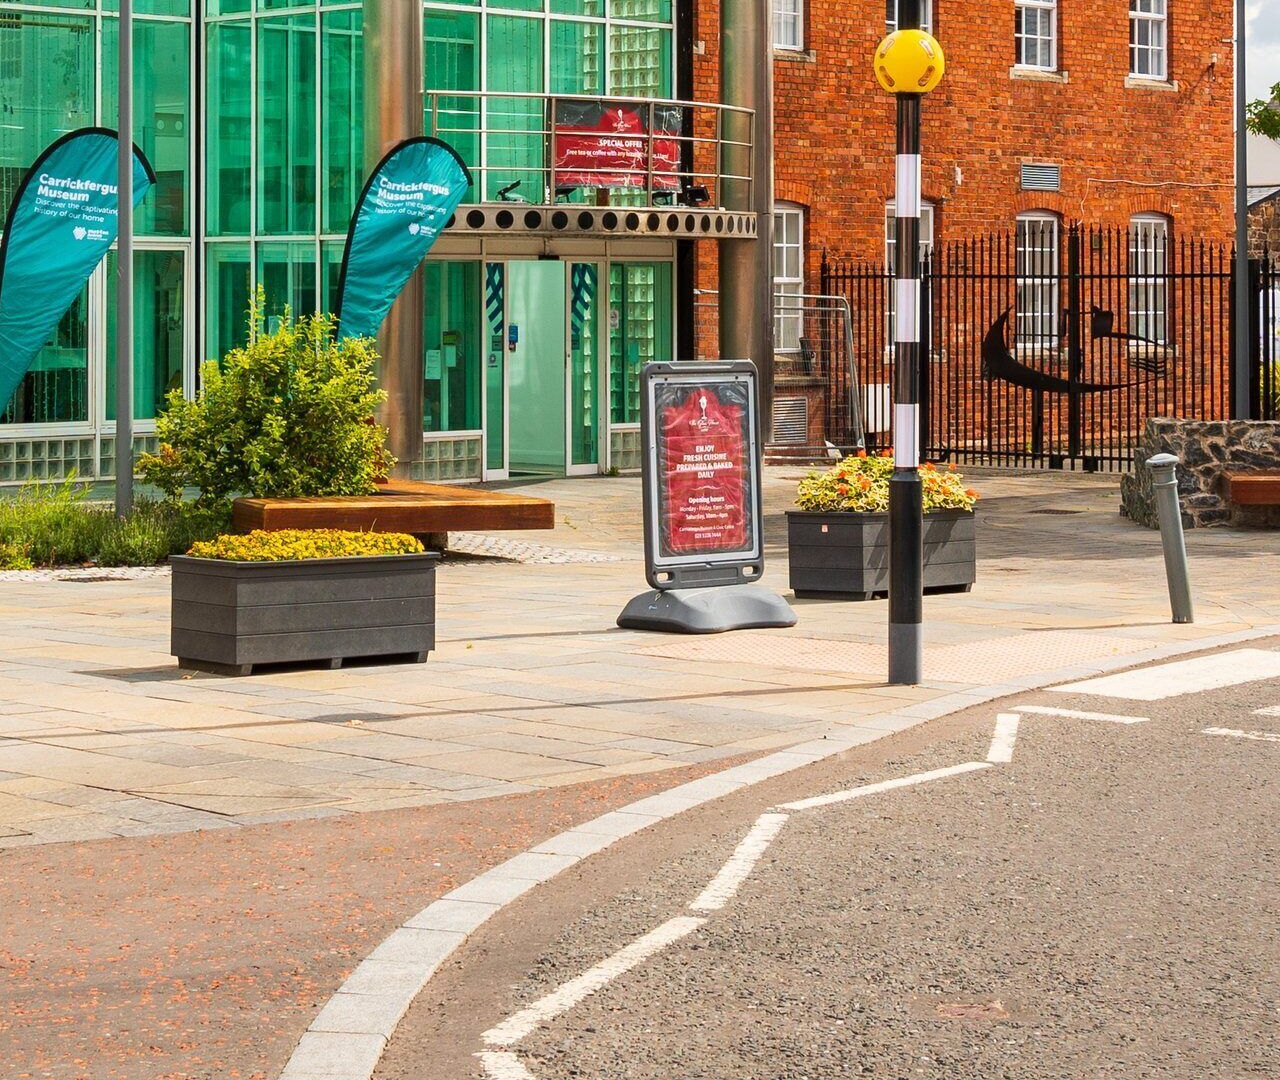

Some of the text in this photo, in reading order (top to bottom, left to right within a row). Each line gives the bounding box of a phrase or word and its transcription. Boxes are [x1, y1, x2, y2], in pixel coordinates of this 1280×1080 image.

[599, 139, 643, 148] SPECIAL OFFER
[39, 173, 118, 195] Carrickfergu
[380, 177, 450, 196] Carrickfergus
[37, 184, 90, 202] Museum
[377, 187, 423, 201] Museum
[35, 197, 67, 208] Discover
[68, 202, 80, 210] the
[34, 206, 58, 217] history
[59, 209, 68, 217] of
[82, 213, 105, 223] home
[695, 445, 715, 453] ENJOY
[683, 452, 727, 462] FRESH CUISINE
[676, 463, 707, 472] PREPARED
[714, 461, 733, 470] BAKED
[697, 471, 715, 479] DAILY
[688, 496, 710, 504] Opening
